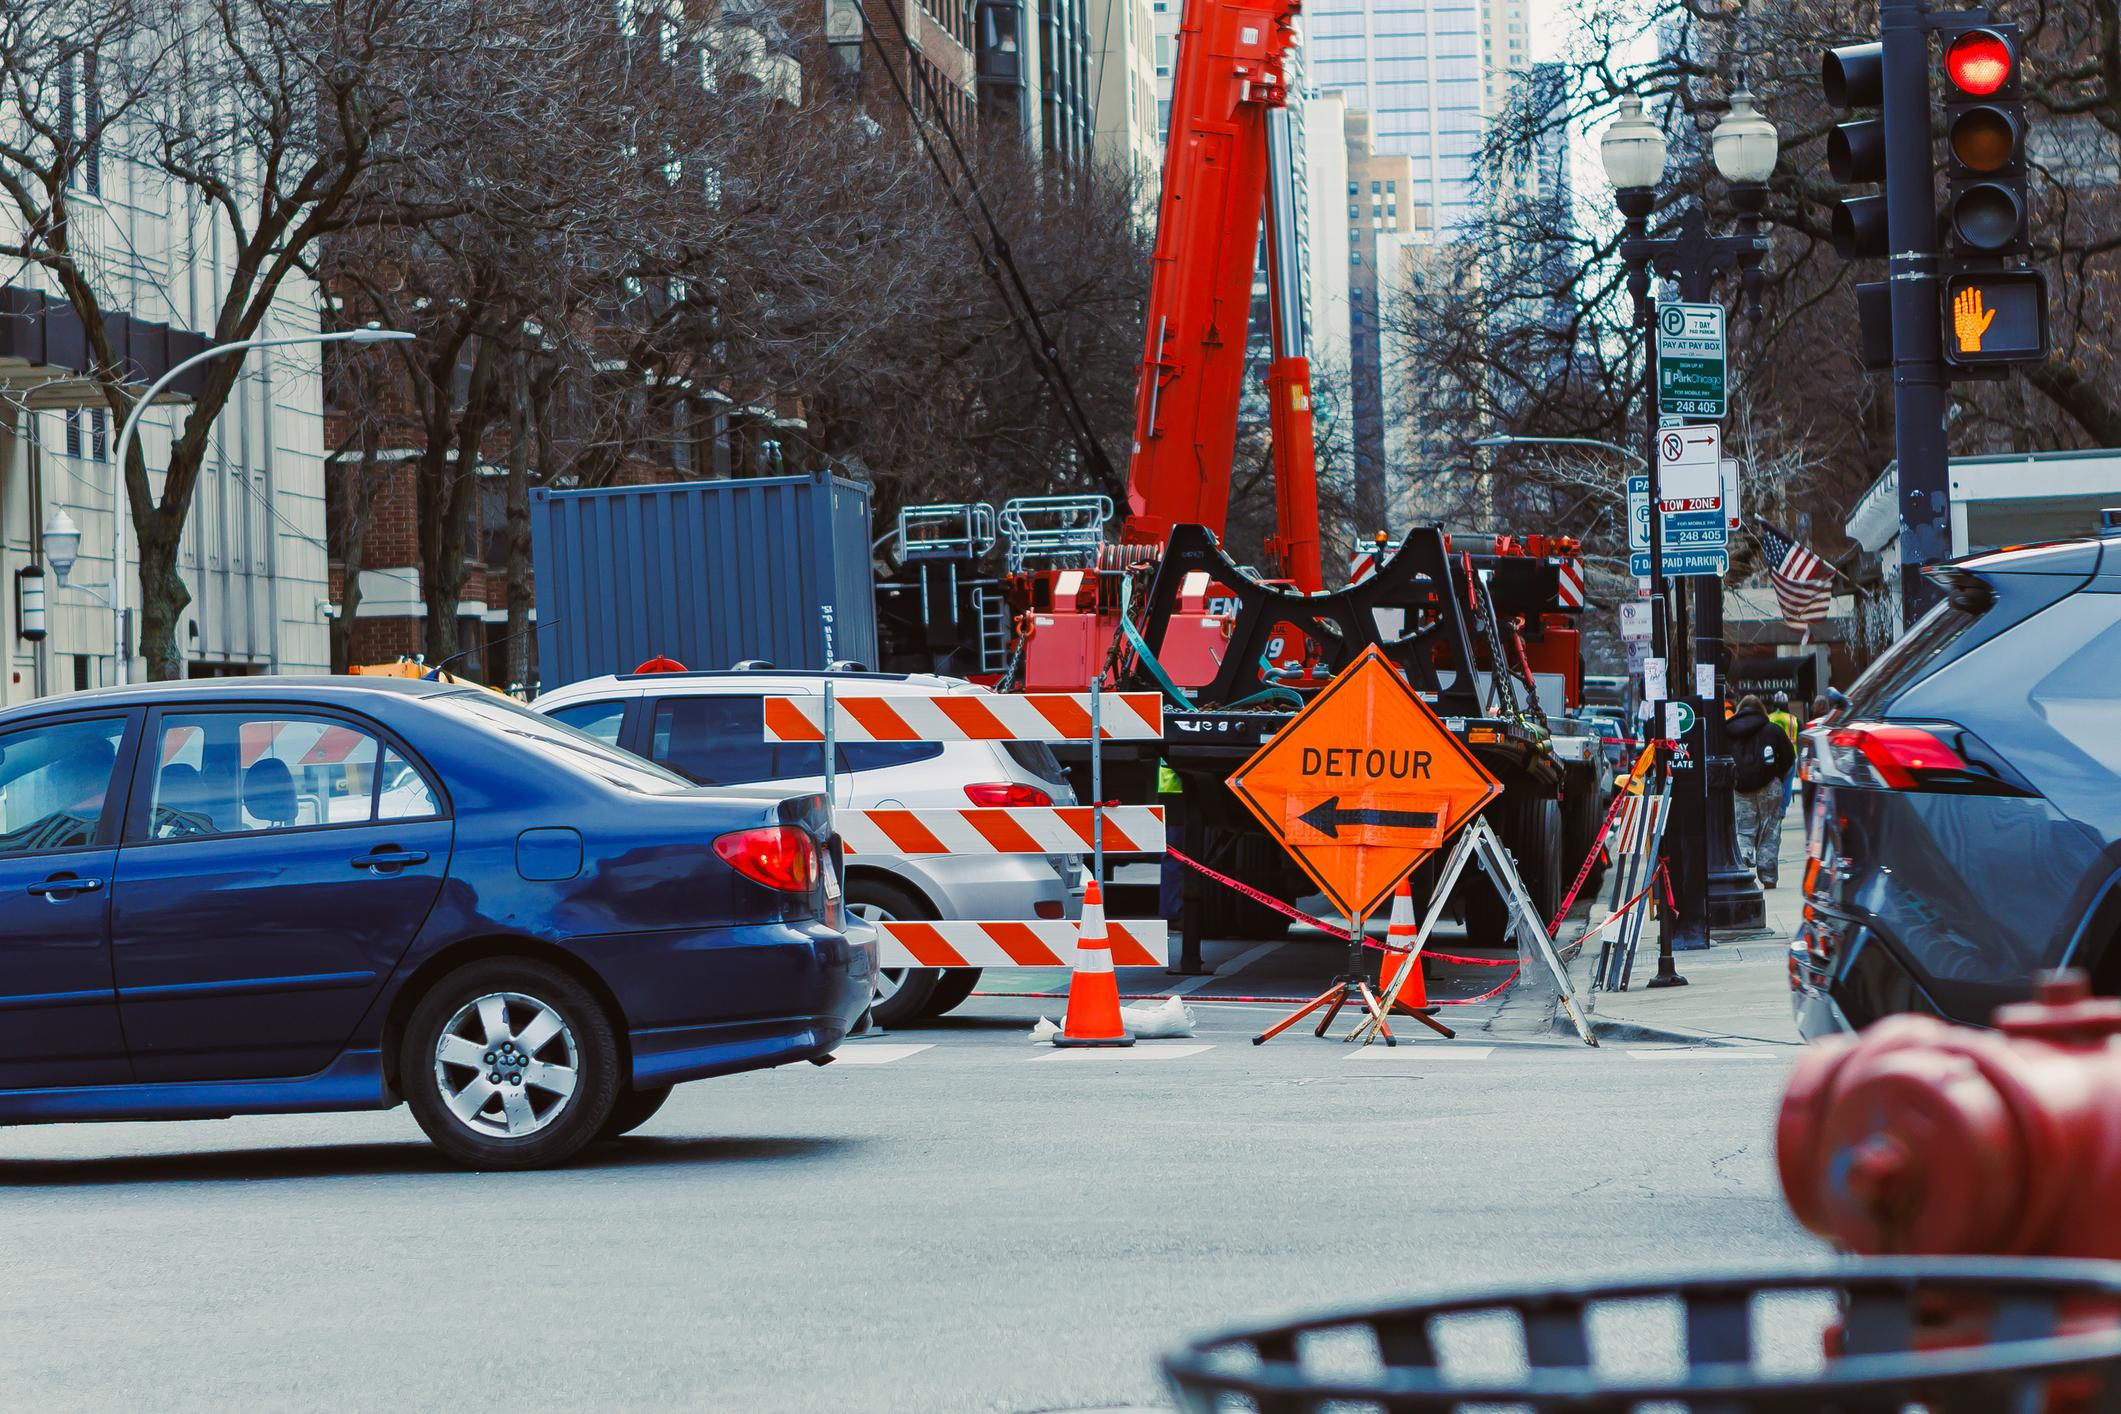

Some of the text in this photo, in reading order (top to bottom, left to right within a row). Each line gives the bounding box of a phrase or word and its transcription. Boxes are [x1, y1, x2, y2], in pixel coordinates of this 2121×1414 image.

[1662, 341, 1720, 351] PAY AT PAY BOX
[1676, 401, 1695, 412] 248
[1697, 401, 1716, 413] 405
[1635, 480, 1649, 491] PA
[1663, 498, 1716, 511] TOW ZONE
[1680, 531, 1699, 541] 248
[1702, 530, 1721, 540] 405
[1634, 559, 1640, 570] 7
[1662, 557, 1683, 568] PAID
[1686, 555, 1725, 567] PARKING
[1674, 752, 1686, 760] BY
[1302, 748, 1433, 779] DETOUR
[1667, 760, 1694, 769] PLATE
[1571, 840, 1602, 894] DANGER
